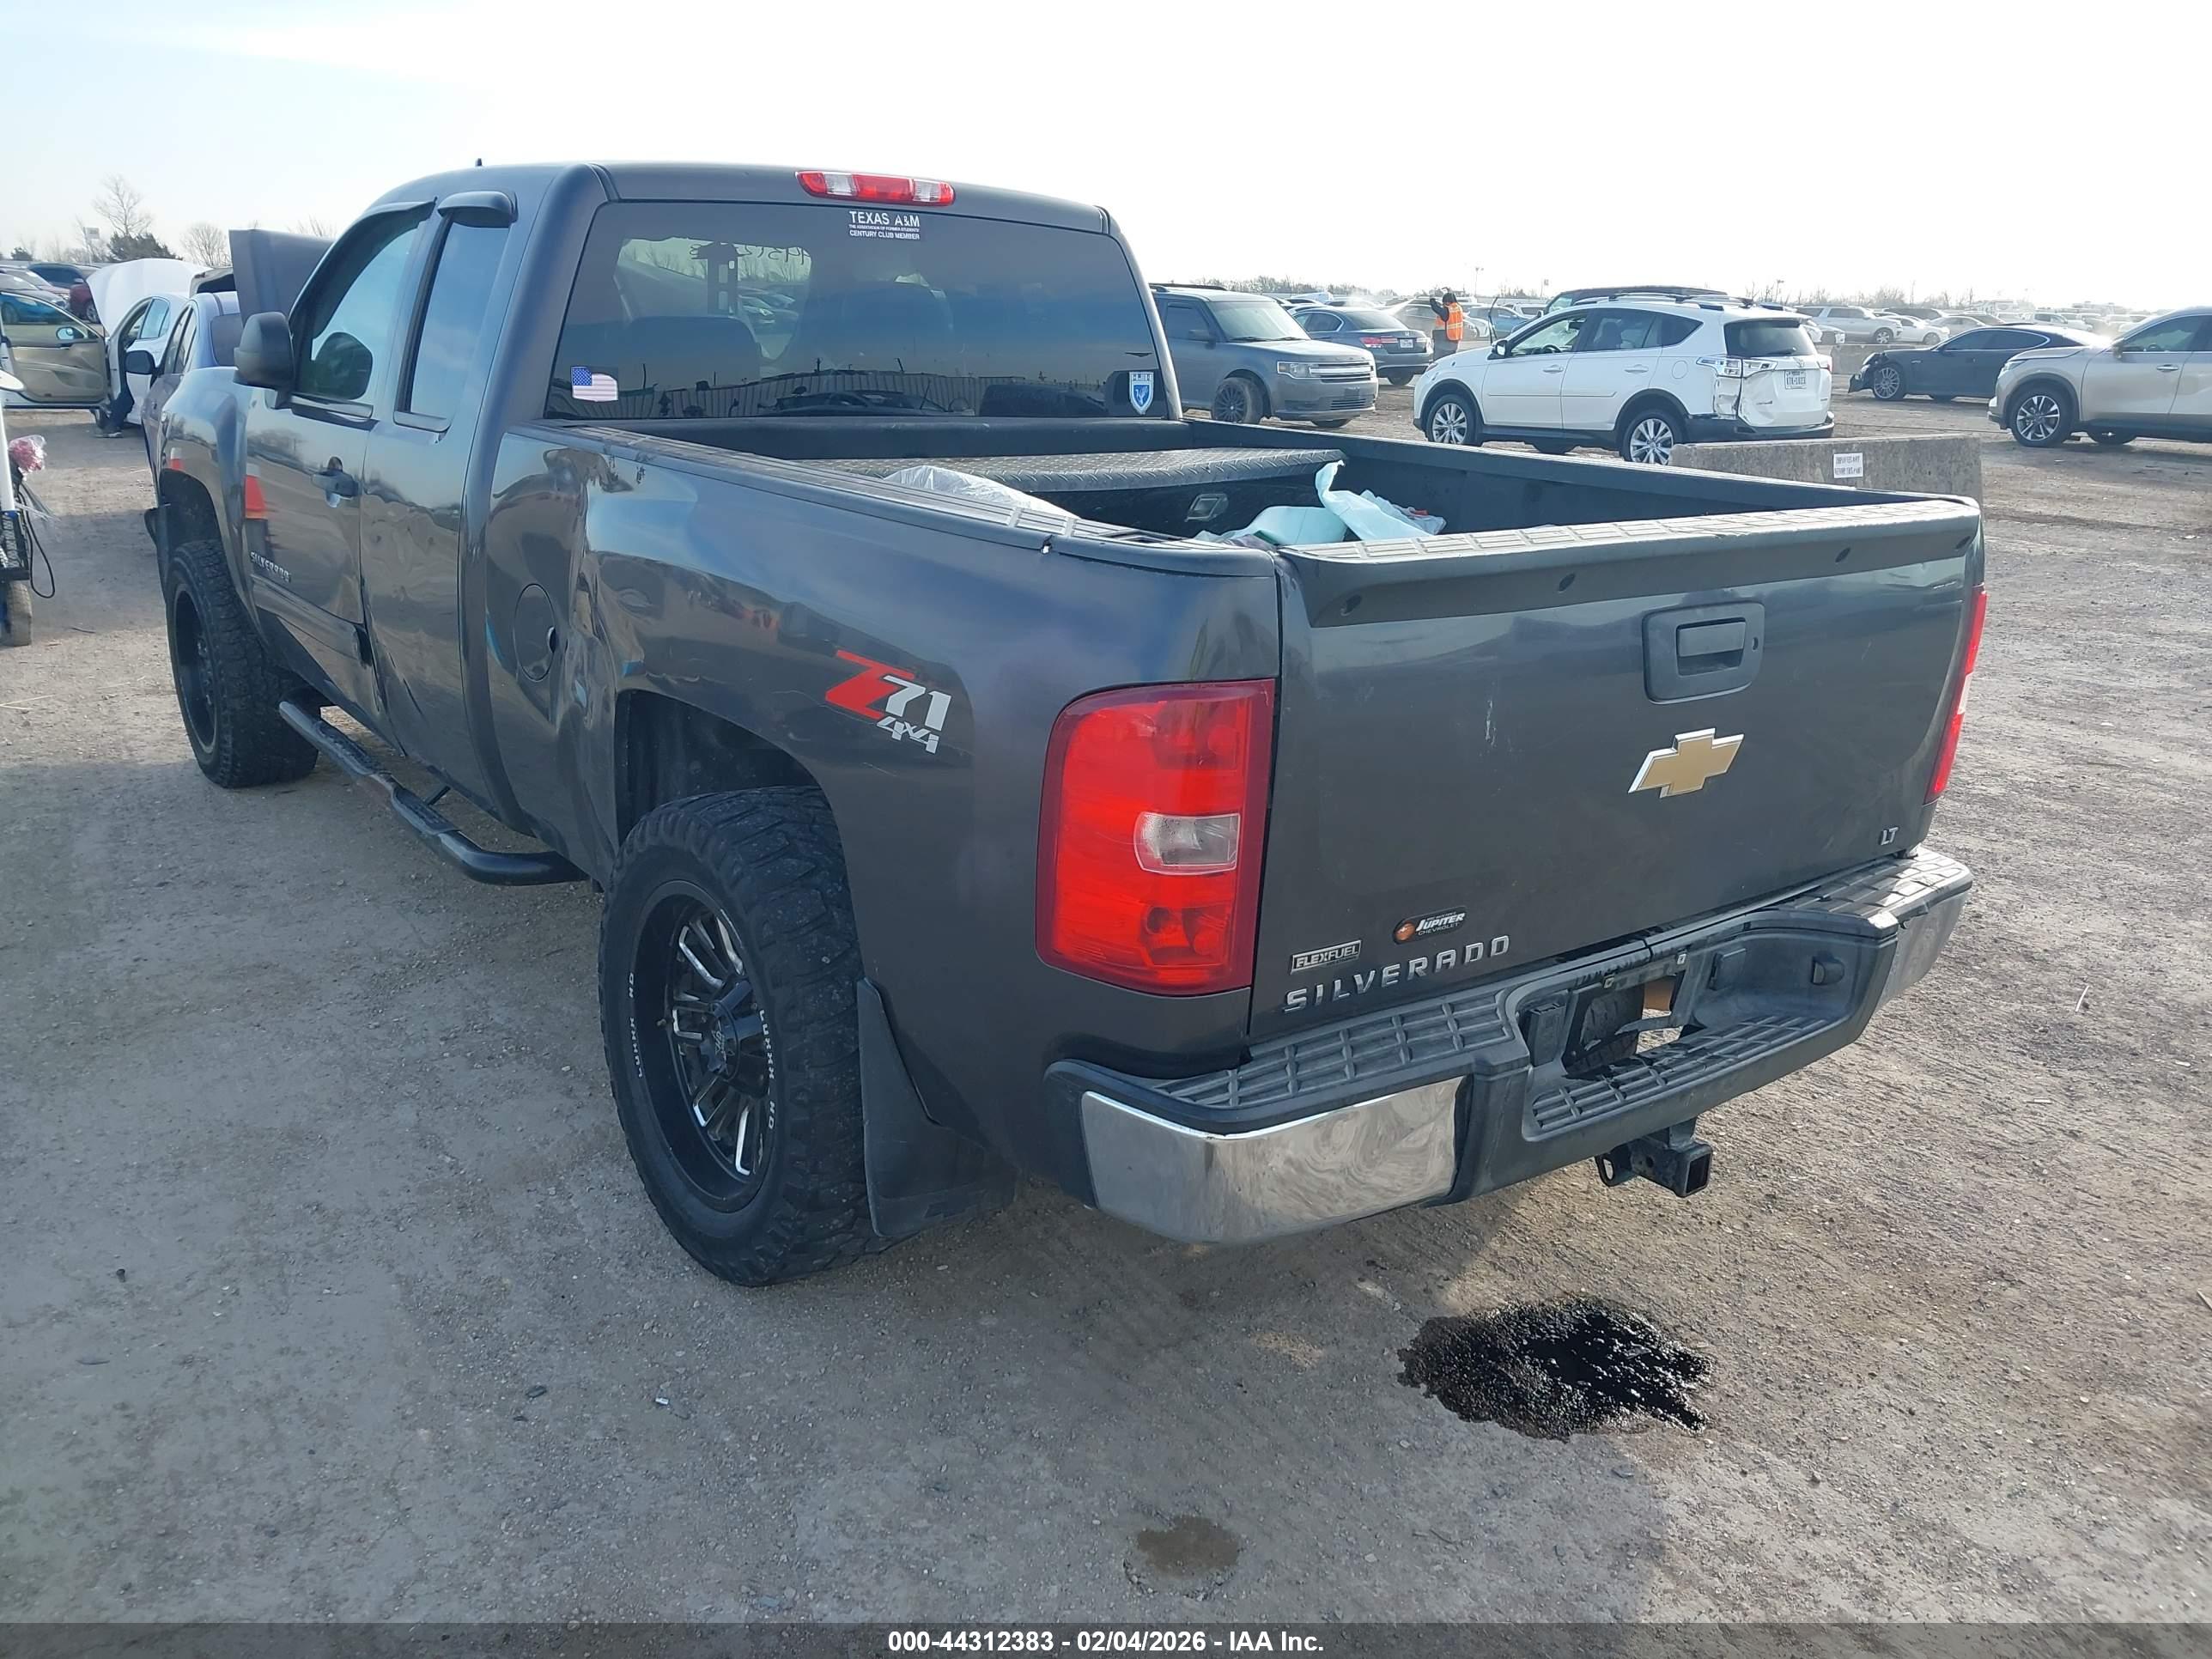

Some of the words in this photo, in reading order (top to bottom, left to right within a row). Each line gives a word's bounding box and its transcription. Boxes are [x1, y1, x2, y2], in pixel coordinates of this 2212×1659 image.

[849, 211, 889, 224] TEXAS
[895, 215, 920, 227] A&M
[849, 229, 878, 238] CENTURY
[250, 551, 290, 582] SILVERADO
[825, 649, 951, 732] Z71
[1881, 826, 1899, 846] LT
[1415, 912, 1466, 933] JUPITER
[1418, 922, 1460, 935] CHEVROLET
[1296, 945, 1358, 968] FLEXFUEL
[1282, 934, 1510, 1013] SILVERADO
